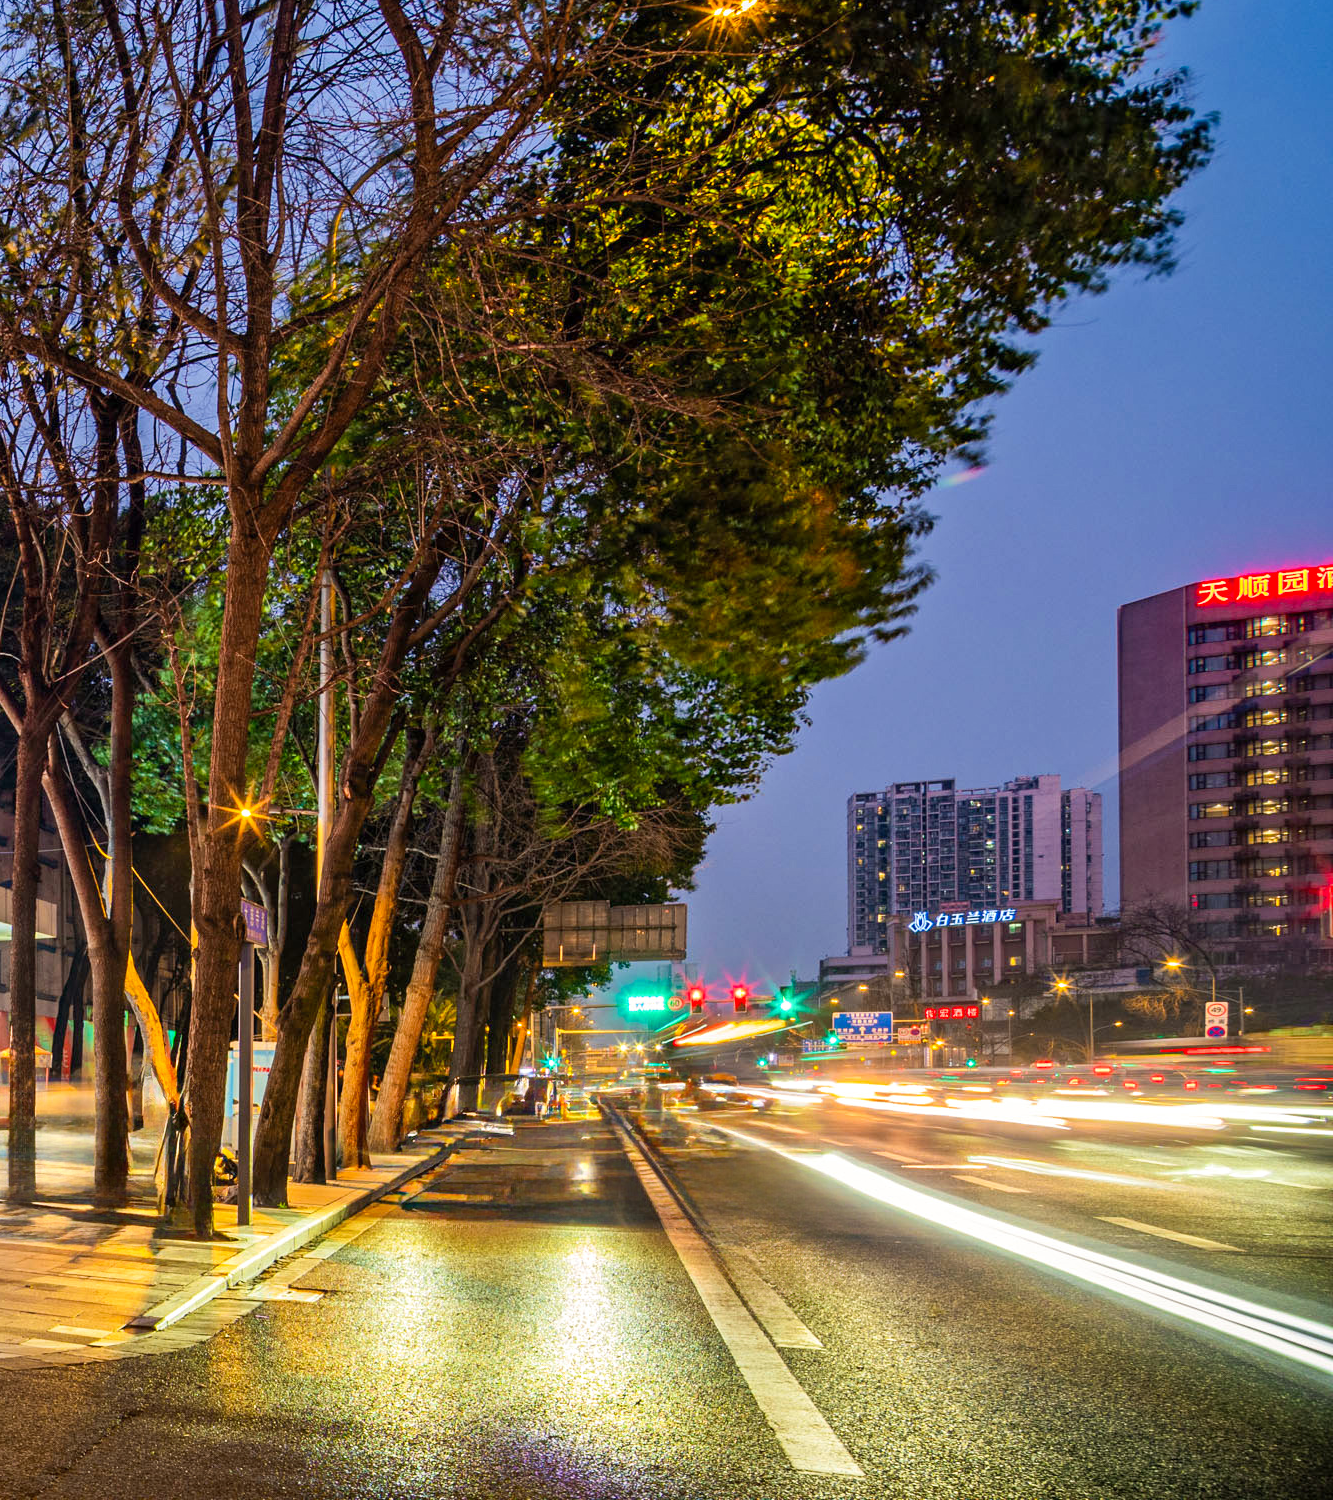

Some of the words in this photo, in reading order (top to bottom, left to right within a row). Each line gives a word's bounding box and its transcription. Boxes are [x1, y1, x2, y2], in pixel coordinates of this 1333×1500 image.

[935, 908, 1017, 927] 白玉兰酒店
